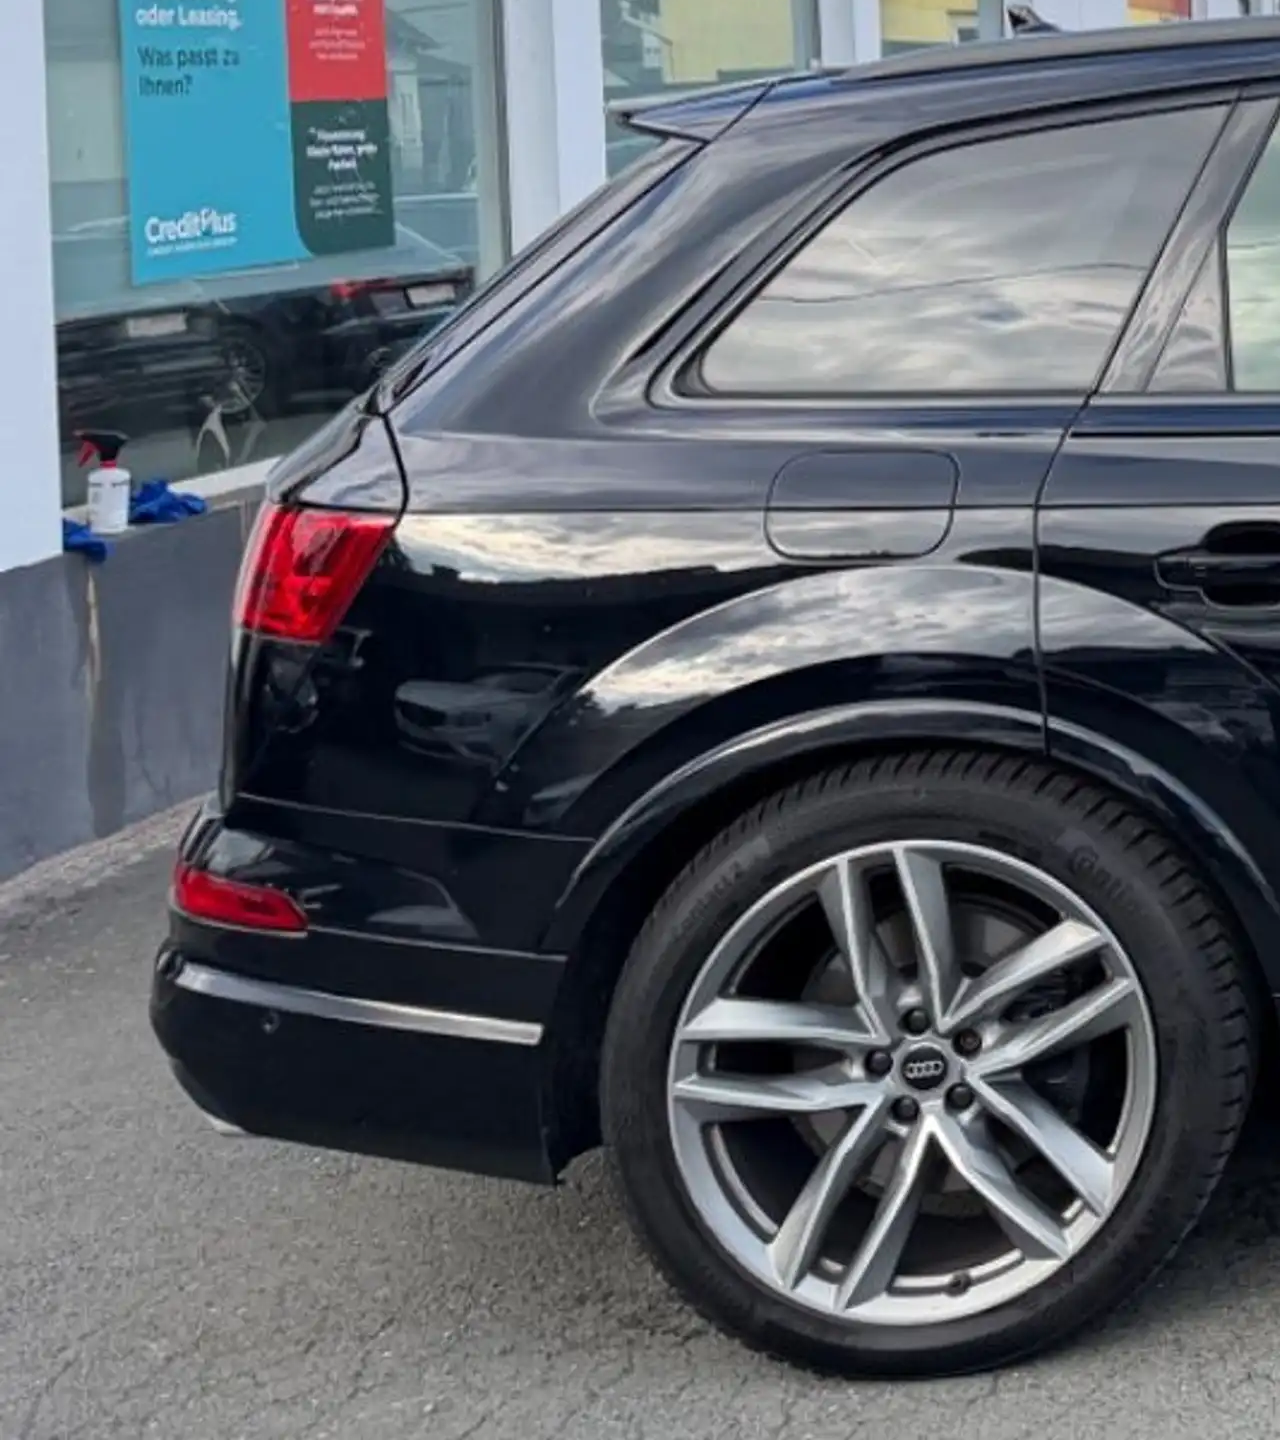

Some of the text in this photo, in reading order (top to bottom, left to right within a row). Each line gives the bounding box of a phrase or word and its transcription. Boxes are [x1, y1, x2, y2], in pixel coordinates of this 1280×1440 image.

[135, 3, 175, 26] oder
[137, 45, 240, 70] Was passt zu
[138, 73, 193, 96] Ihnen?
[144, 208, 238, 244] CreditPlus
